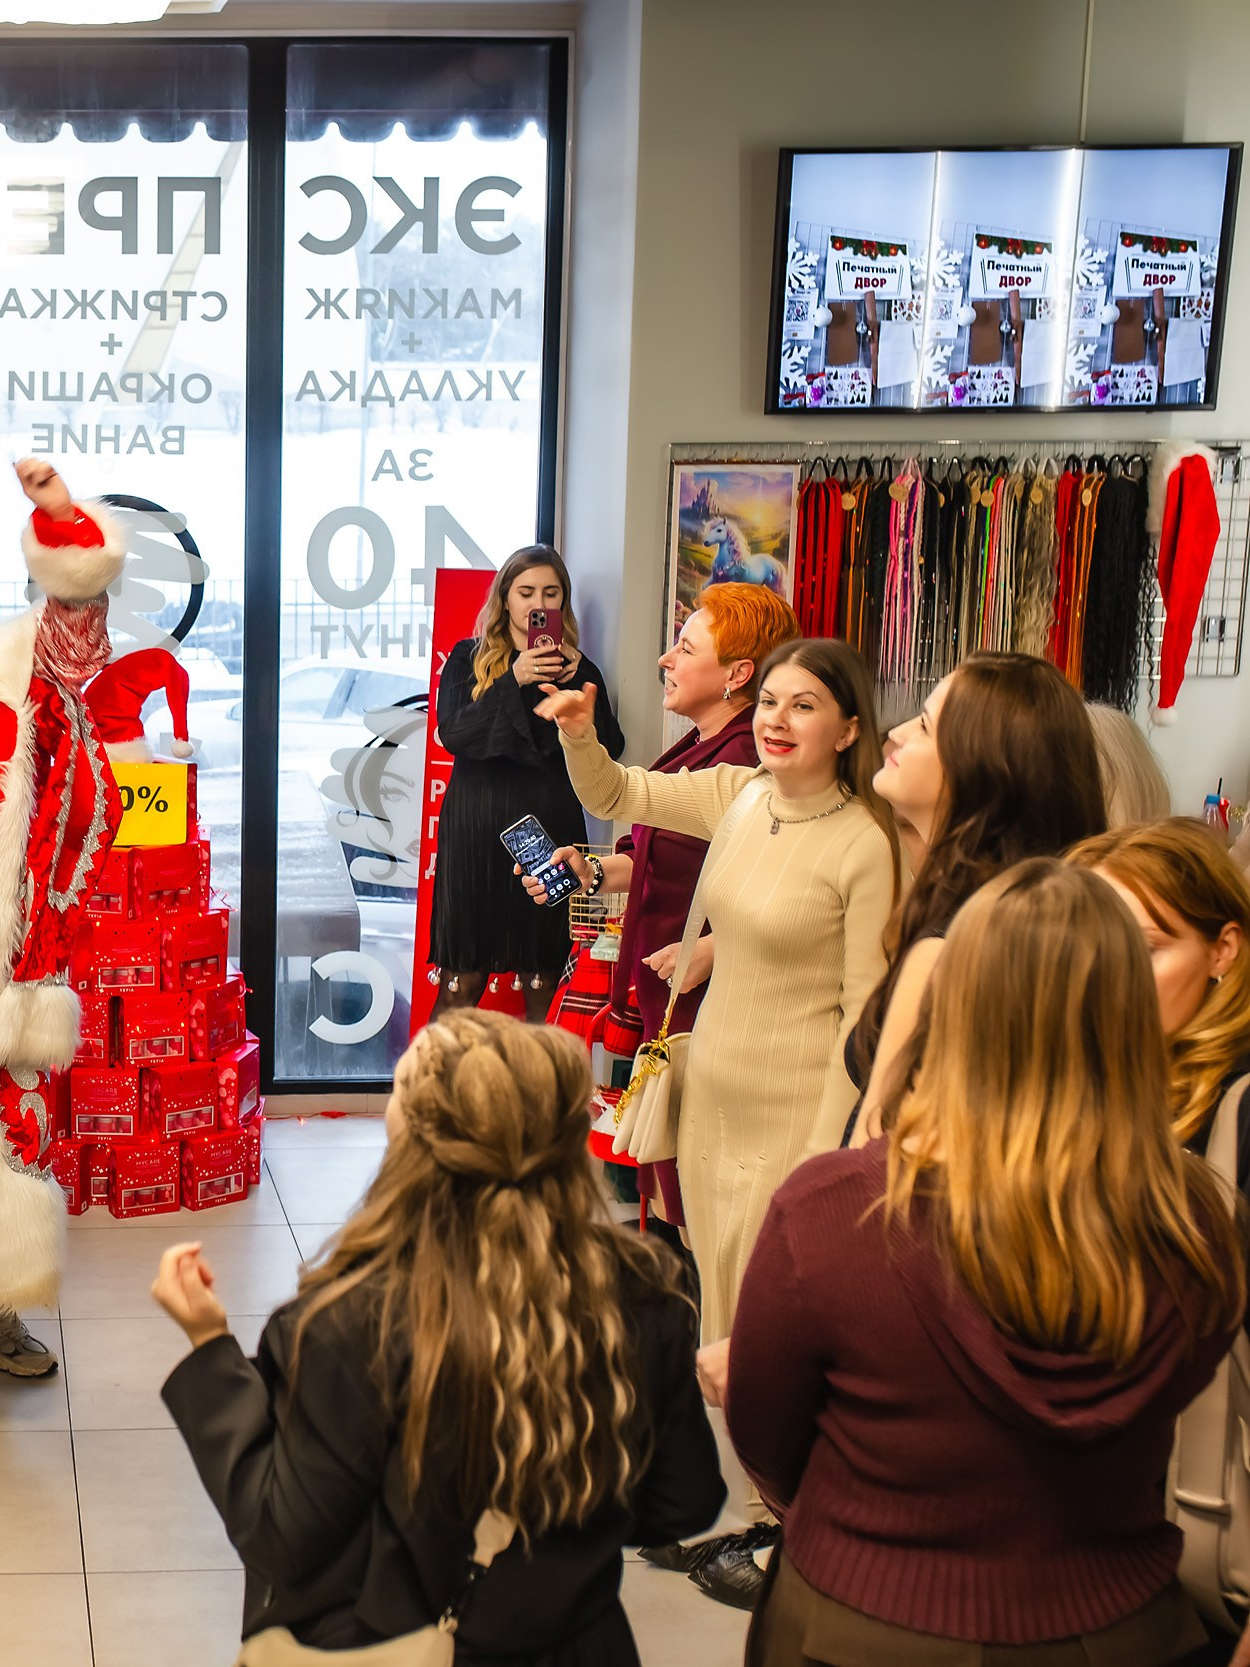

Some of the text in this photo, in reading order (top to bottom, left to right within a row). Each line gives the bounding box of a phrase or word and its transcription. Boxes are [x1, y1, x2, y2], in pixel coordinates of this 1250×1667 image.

[842, 260, 898, 276] Печатный
[987, 259, 1043, 274] Печатный
[1131, 257, 1187, 273] Печатный
[854, 276, 888, 290] ДВОР
[999, 275, 1032, 289] ДВОР
[1143, 274, 1176, 288] ДВОР
